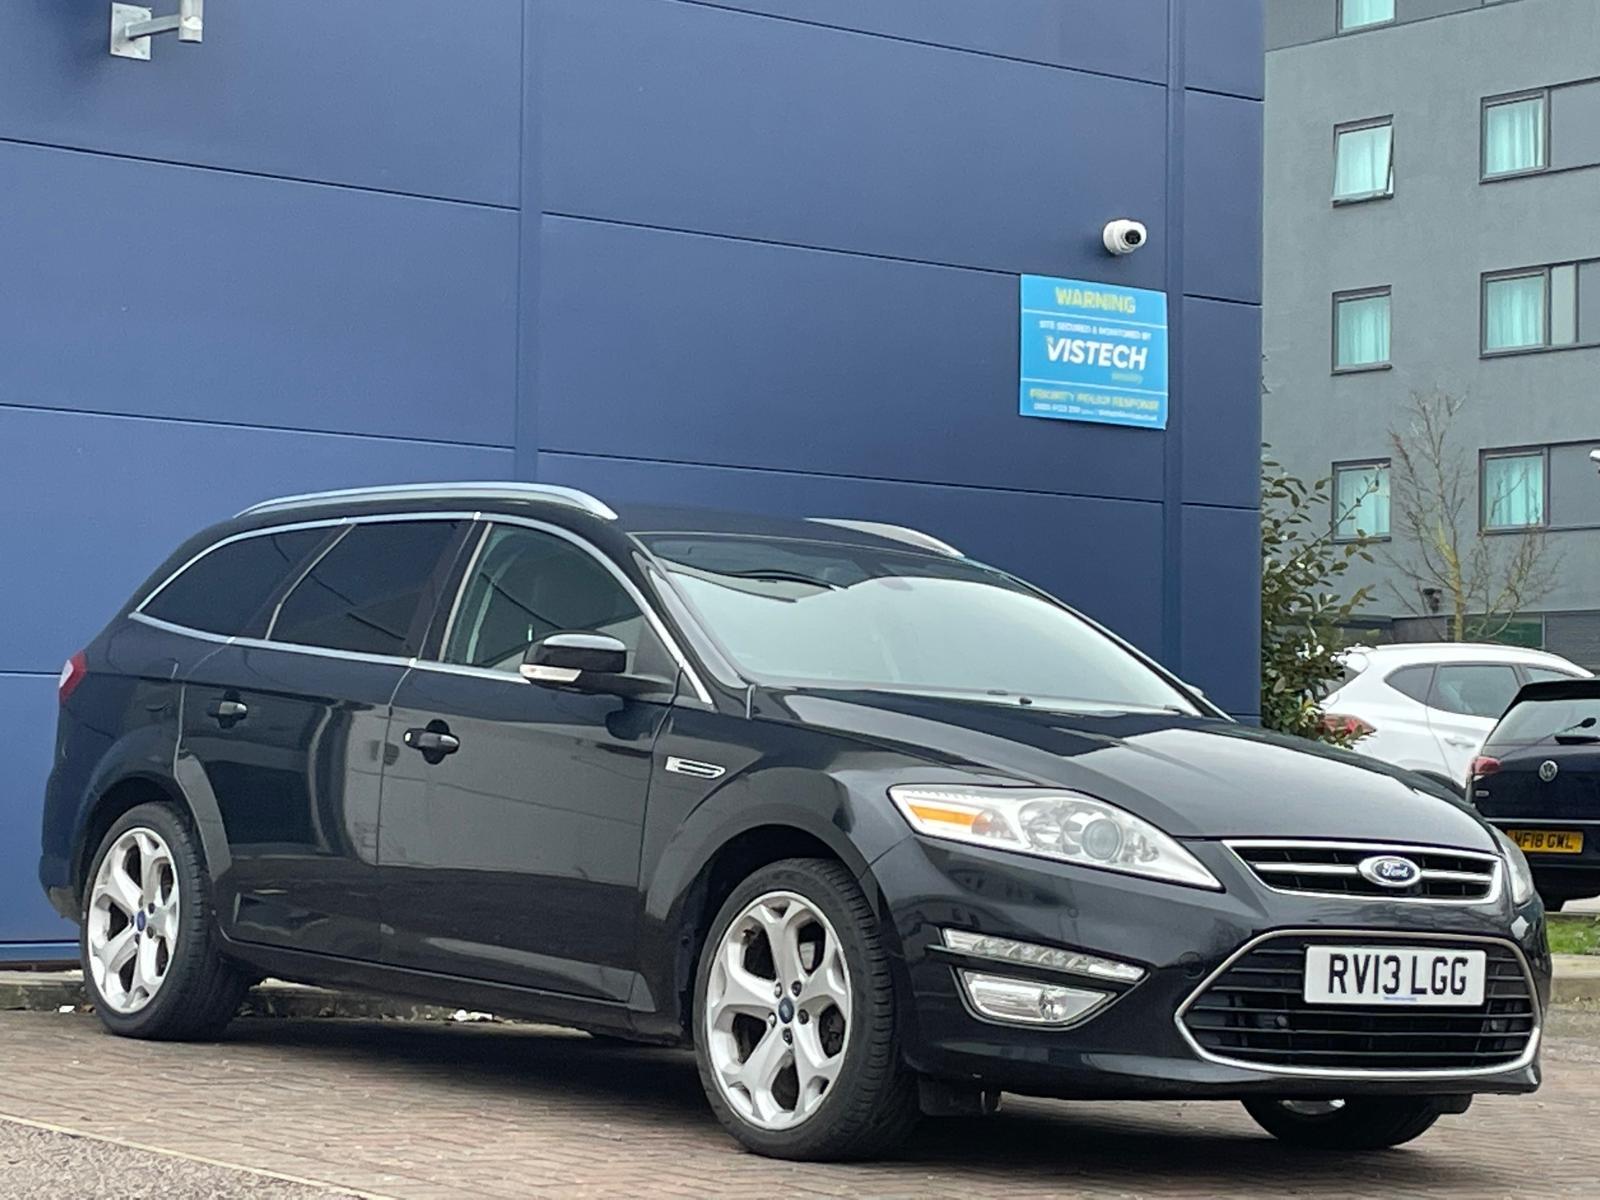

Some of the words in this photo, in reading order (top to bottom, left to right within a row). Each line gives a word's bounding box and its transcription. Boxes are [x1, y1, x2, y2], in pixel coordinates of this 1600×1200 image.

[1056, 286, 1136, 314] WARNING
[1046, 335, 1148, 371] VISTECH
[1381, 861, 1410, 878] Ford
[1328, 953, 1401, 995] RV13
[1411, 955, 1469, 996] LGG
